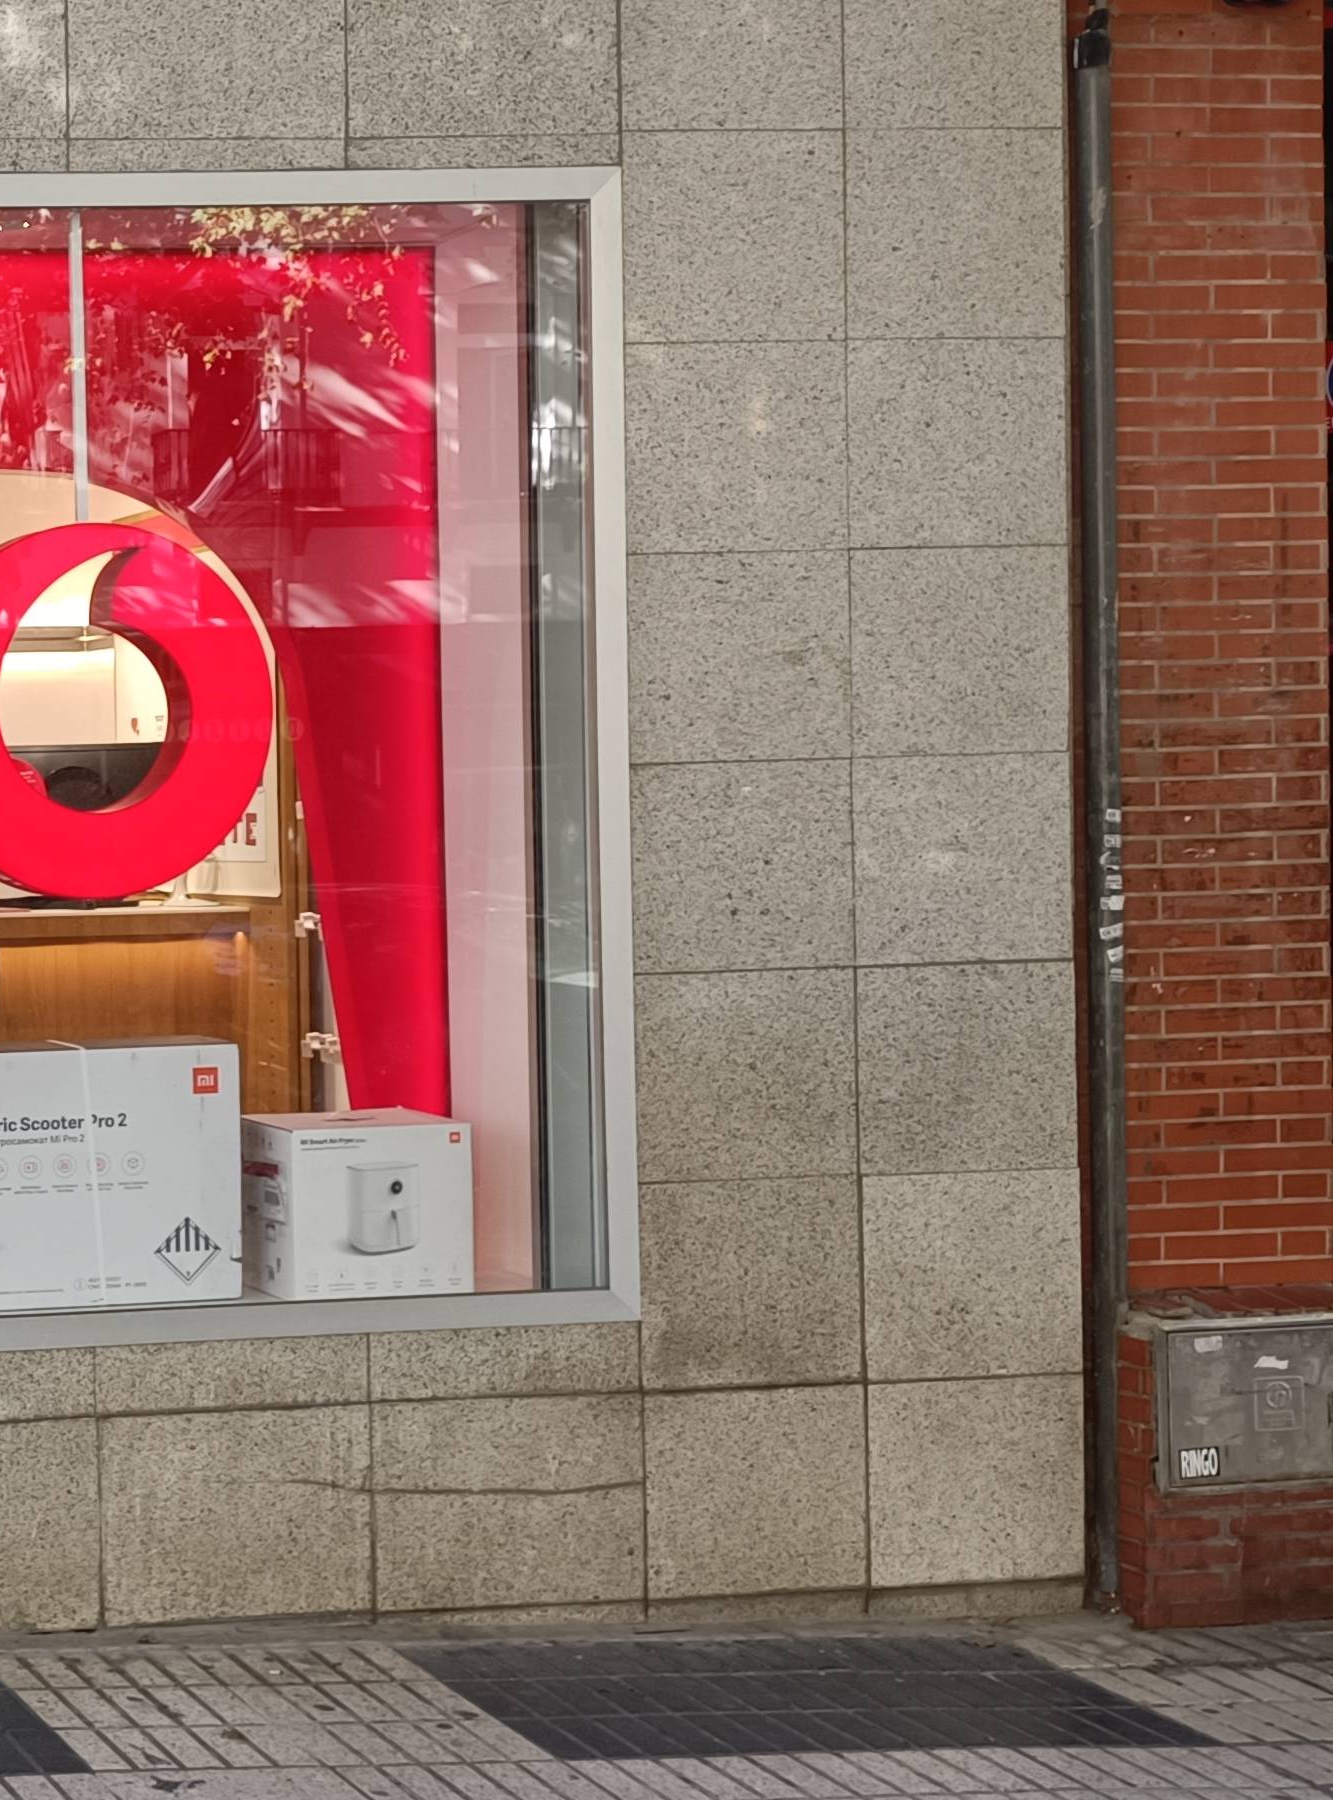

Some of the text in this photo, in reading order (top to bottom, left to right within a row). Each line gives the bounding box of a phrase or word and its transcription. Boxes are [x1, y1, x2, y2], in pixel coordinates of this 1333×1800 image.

[20, 1116, 85, 1132] Scooter
[117, 1112, 128, 1128] 2
[1180, 1447, 1219, 1479] RINGO
